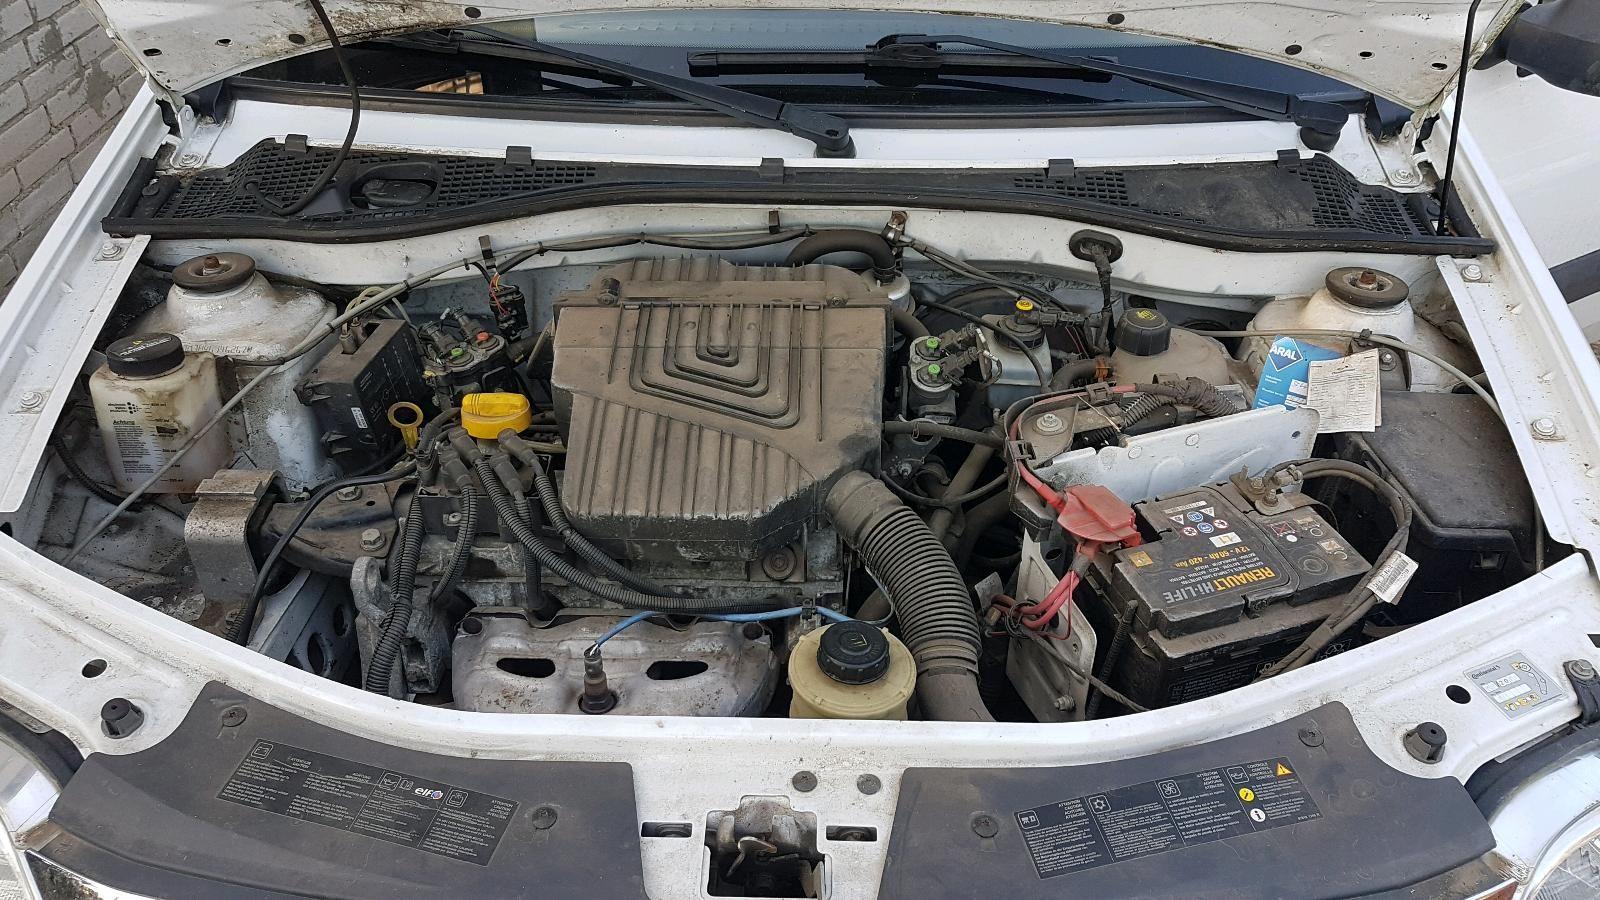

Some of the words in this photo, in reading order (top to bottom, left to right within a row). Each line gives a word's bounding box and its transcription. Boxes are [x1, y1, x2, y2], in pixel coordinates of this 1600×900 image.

[1270, 346, 1298, 361] ARAL
[1188, 557, 1204, 565] 420
[1214, 567, 1275, 590] RENAULT
[414, 786, 434, 797] elf
